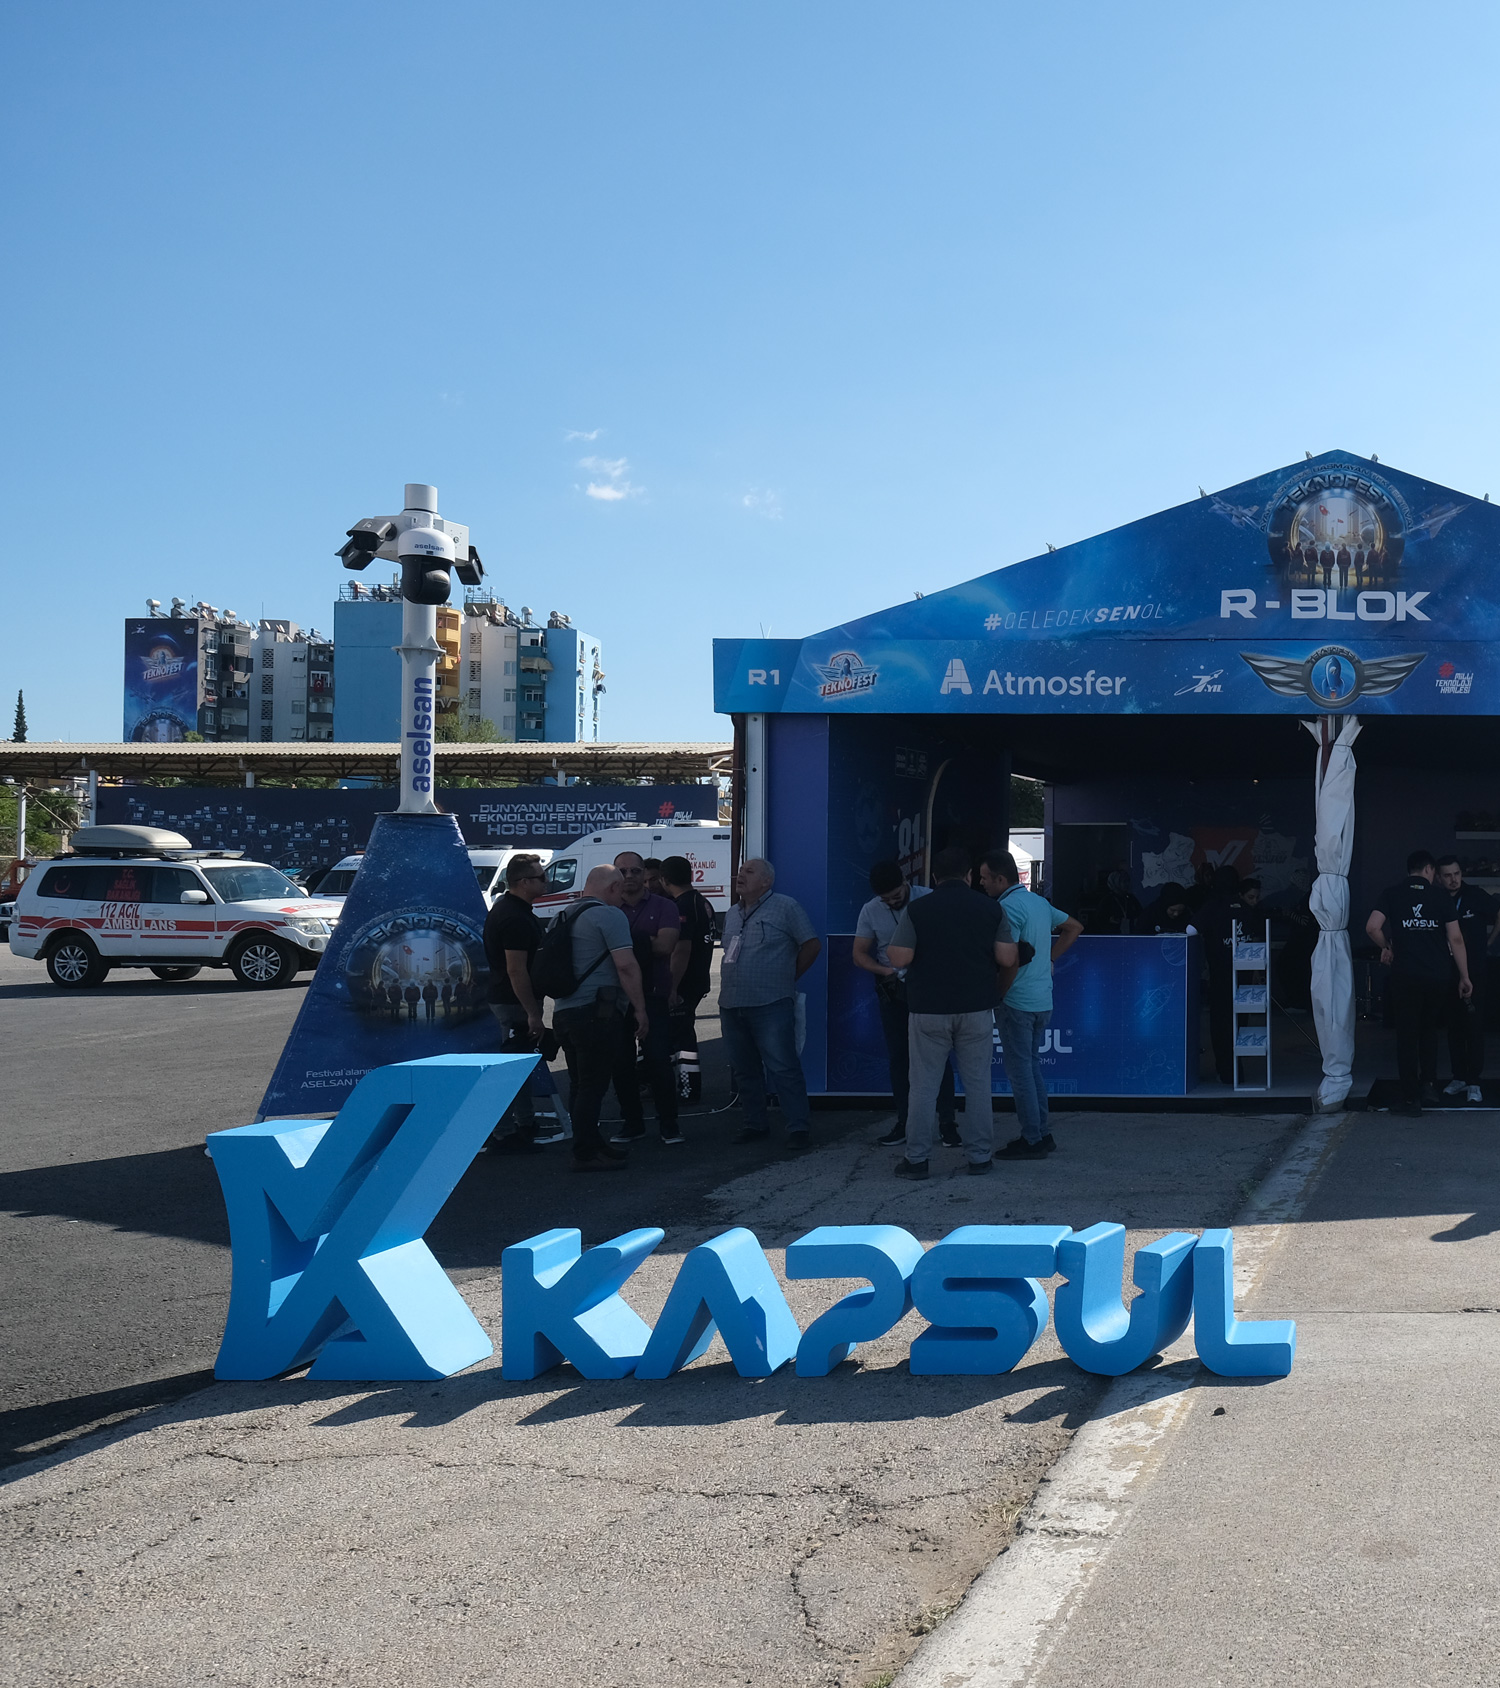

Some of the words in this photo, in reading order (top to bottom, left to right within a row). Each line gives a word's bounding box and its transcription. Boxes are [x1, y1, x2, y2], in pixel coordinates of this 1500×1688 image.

[1278, 474, 1393, 513] TEKNOFEST
[1220, 589, 1257, 618] R
[1291, 589, 1431, 621] BLOK
[144, 661, 183, 680] TEKNOFEST
[749, 670, 780, 685] R1
[820, 673, 877, 696] TEKNOFEST
[983, 670, 1127, 695] Atmosfer
[406, 677, 432, 793] aselsan
[555, 803, 575, 812] EN
[487, 823, 527, 836] HOŞ
[690, 861, 717, 869] AKANLIĞI
[100, 903, 117, 918] 112
[102, 919, 177, 931] AMBULANS
[360, 916, 478, 948] TEKNOFEST
[306, 1068, 343, 1078] Festival
[301, 1078, 353, 1089] ASELSAN
